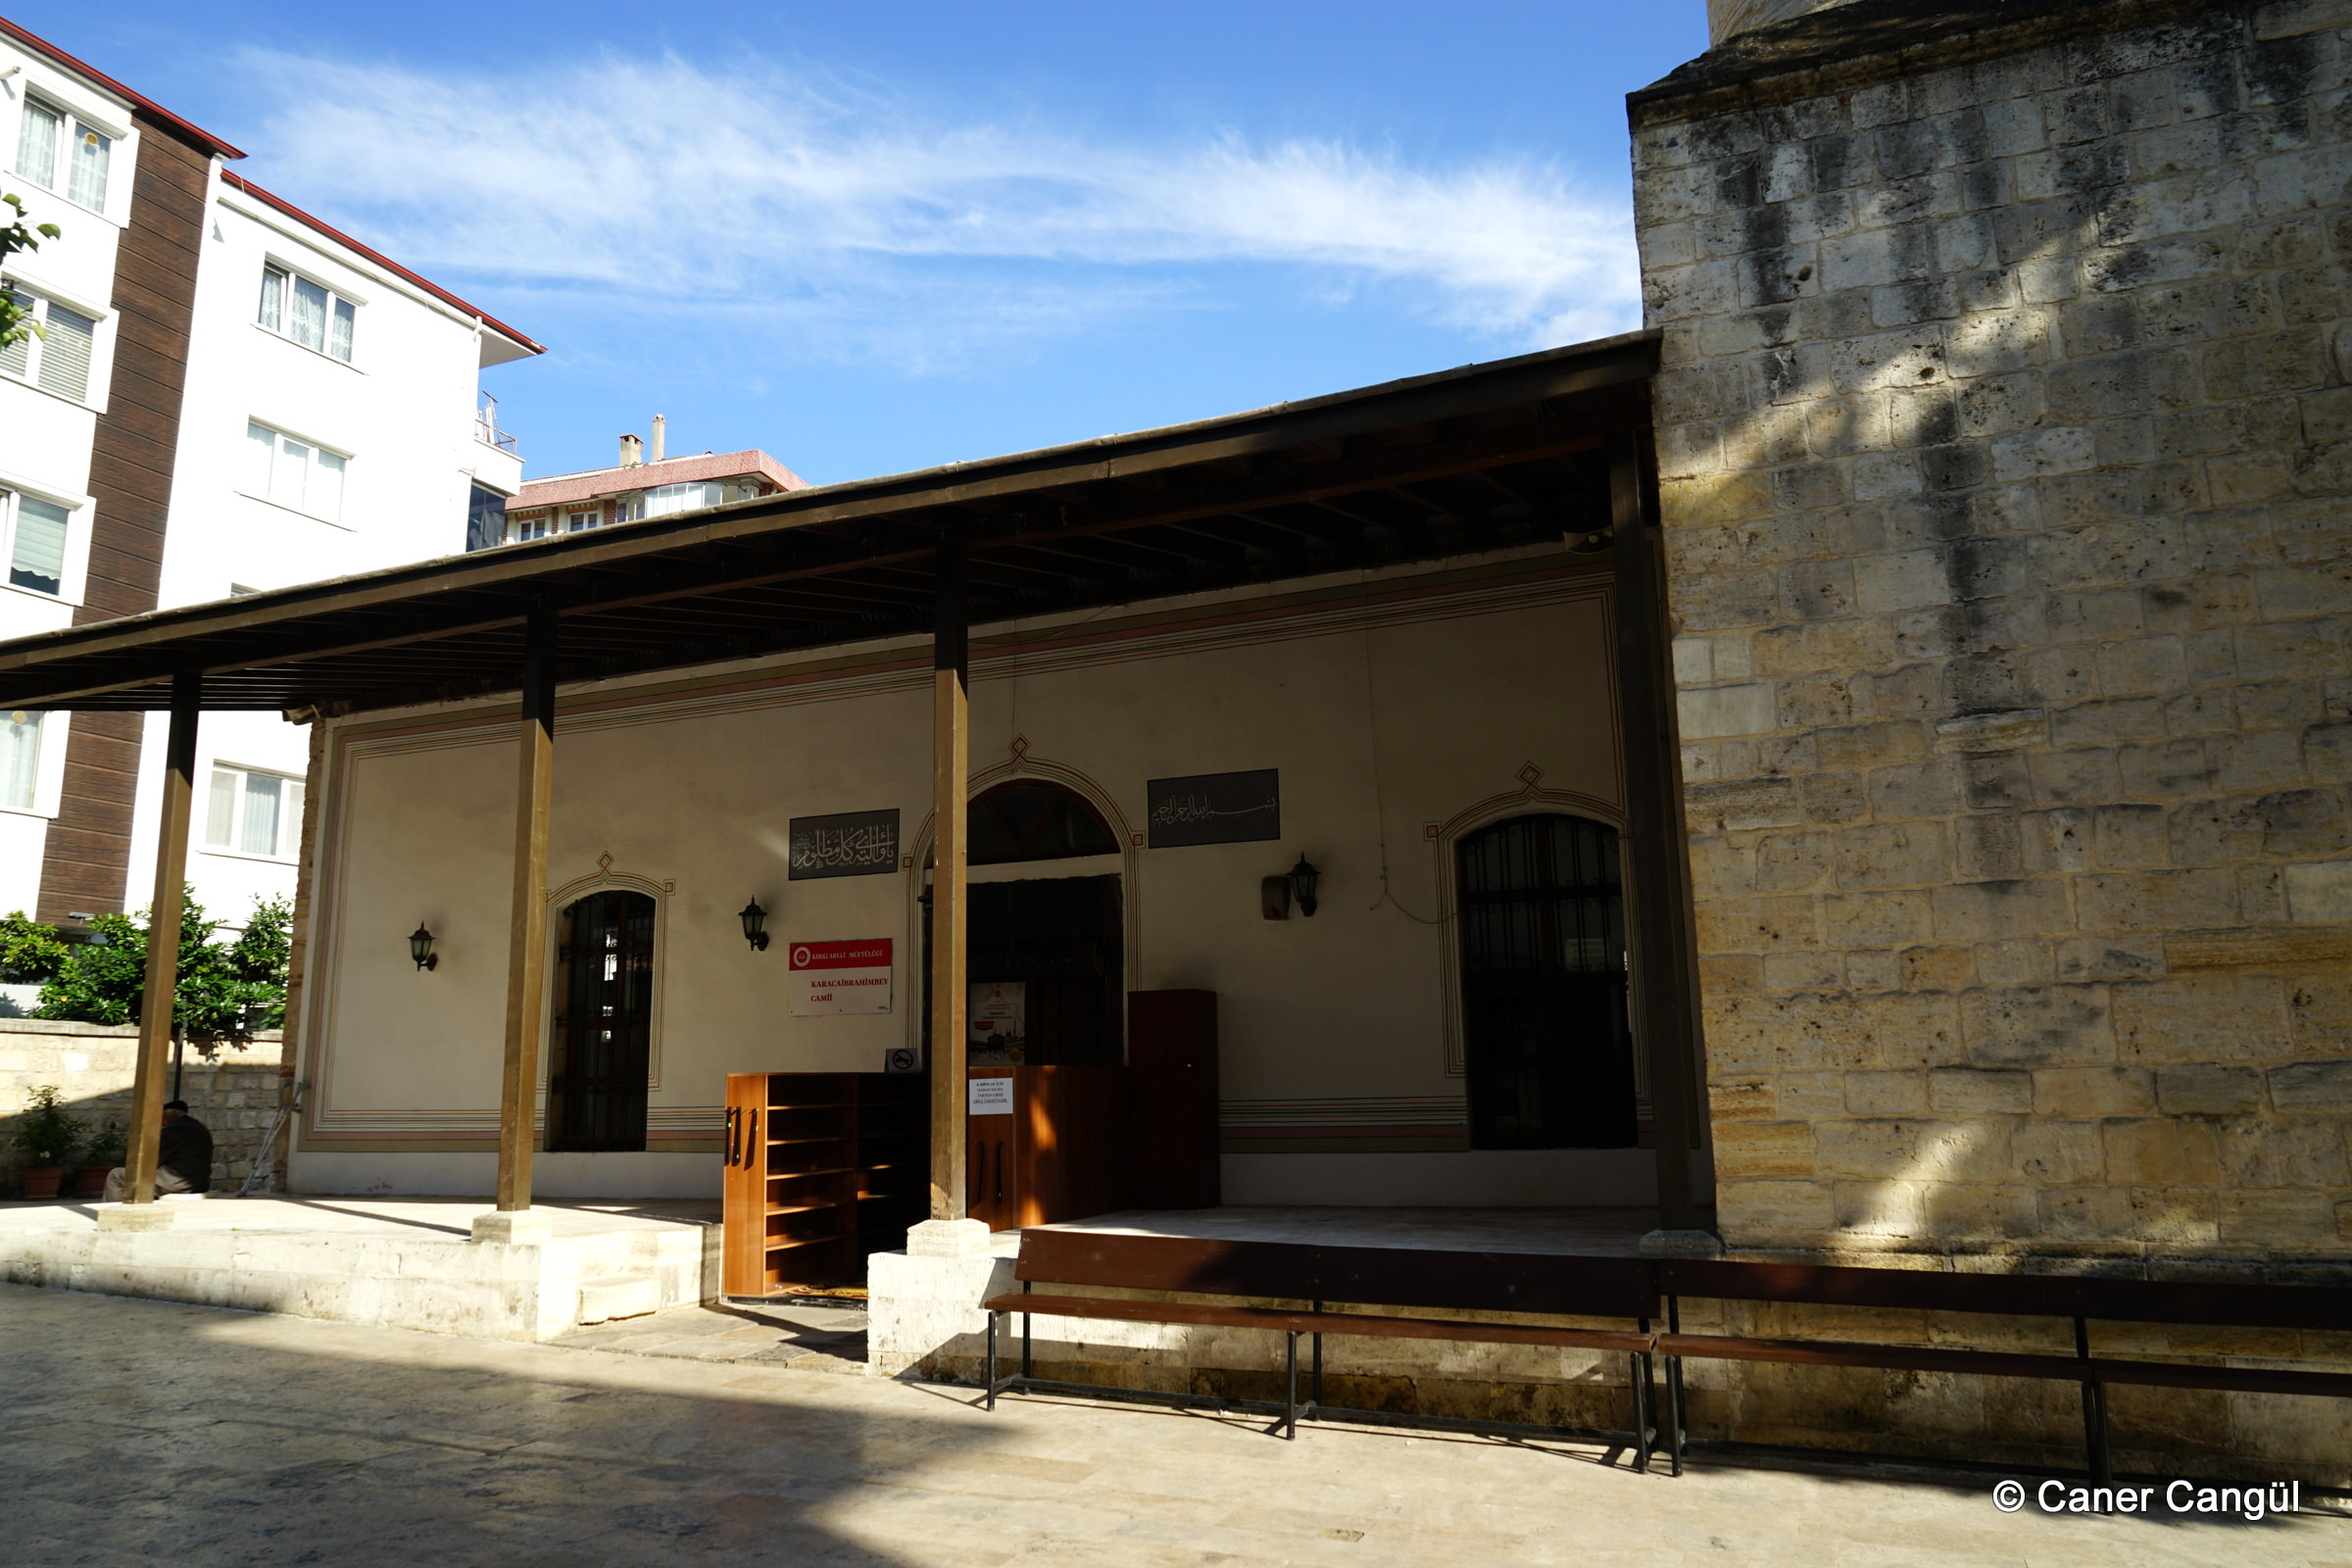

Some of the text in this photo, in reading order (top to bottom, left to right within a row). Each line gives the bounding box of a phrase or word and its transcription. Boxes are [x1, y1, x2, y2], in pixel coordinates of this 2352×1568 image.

[811, 950, 884, 960] KIRKLARELİ MÜFTÜLÜĞÜ
[811, 977, 889, 988] KARACAİBRAHİMBEY
[810, 992, 833, 1003] CAMİİ
